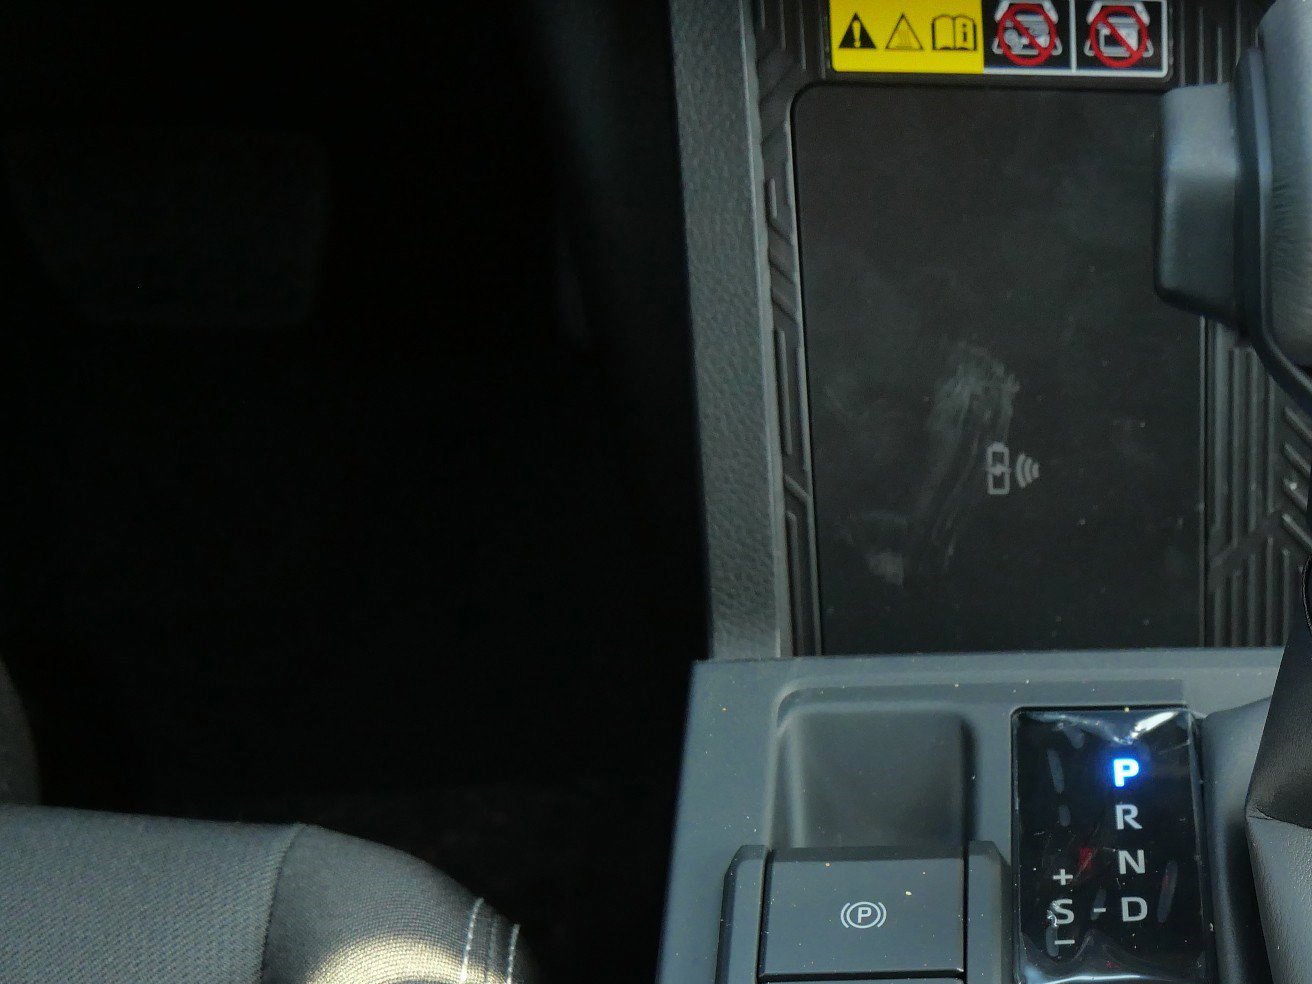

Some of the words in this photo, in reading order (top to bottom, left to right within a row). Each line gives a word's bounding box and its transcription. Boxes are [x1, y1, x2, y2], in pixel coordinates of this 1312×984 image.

[1113, 758, 1140, 787] P
[1115, 804, 1143, 830] R
[1118, 849, 1146, 875] N
[1051, 898, 1076, 925] S
[1121, 896, 1148, 922] D
